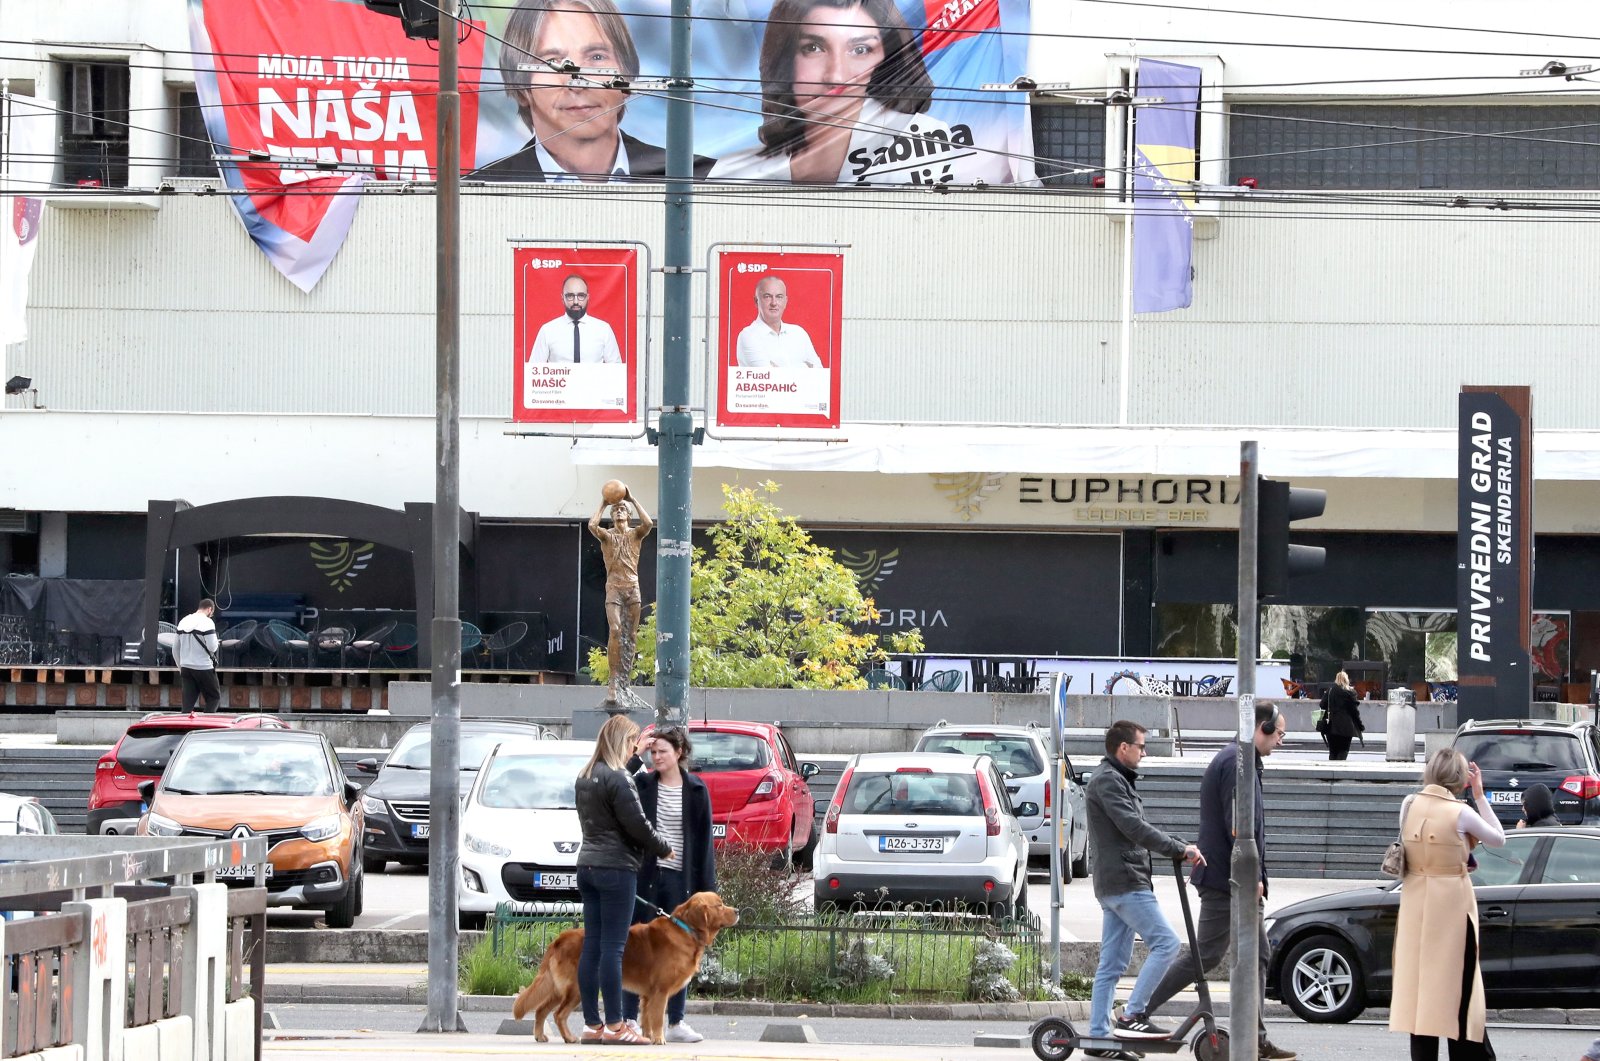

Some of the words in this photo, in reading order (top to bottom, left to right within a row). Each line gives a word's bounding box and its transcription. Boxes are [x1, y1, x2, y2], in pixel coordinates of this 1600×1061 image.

[258, 82, 423, 141] NAŠA
[848, 124, 974, 175] Sabina
[542, 259, 562, 269] SDP
[747, 264, 767, 273] SDP
[532, 366, 541, 375] 3.
[543, 366, 571, 375] Damir
[736, 371, 744, 380] 2.
[746, 371, 770, 380] Fuad
[532, 378, 566, 388] MAŠIĆ
[736, 382, 797, 392] ABASPAHIĆ
[1471, 411, 1492, 492] GRAD
[1019, 477, 1240, 504] EUPHORI
[1497, 436, 1512, 565] SKENDERIJA
[1167, 508, 1209, 522] BAR
[1470, 501, 1491, 662] PRIVREDNI
[887, 838, 941, 849] A26-J-373
